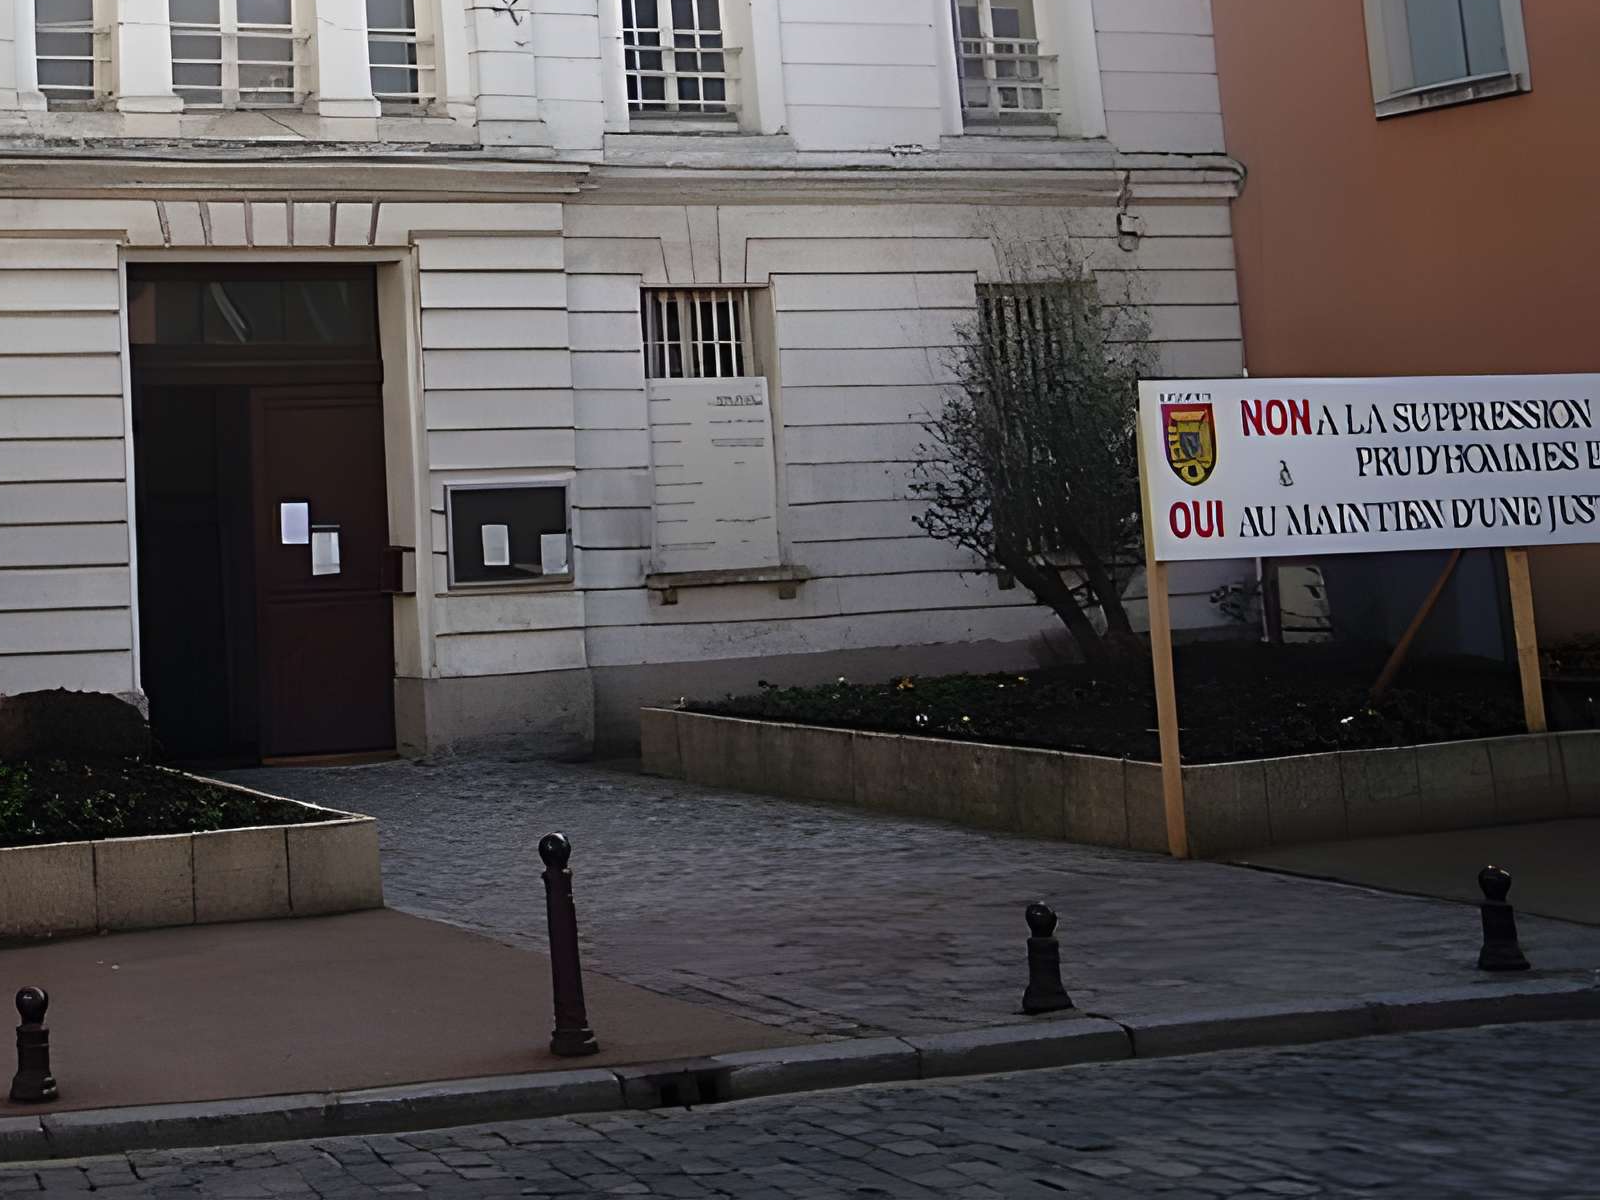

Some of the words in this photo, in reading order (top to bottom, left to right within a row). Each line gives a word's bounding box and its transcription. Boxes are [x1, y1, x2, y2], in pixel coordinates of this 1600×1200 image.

[1240, 399, 1313, 437] NON
[1345, 403, 1388, 435] LA
[1392, 398, 1592, 433] SUPPRESSION
[1356, 441, 1580, 477] PRUD'HOMMES
[1169, 500, 1225, 539] OUI
[1240, 505, 1276, 537] AU
[1286, 499, 1445, 536] MAINTIEN
[1451, 496, 1542, 529] D'UNE
